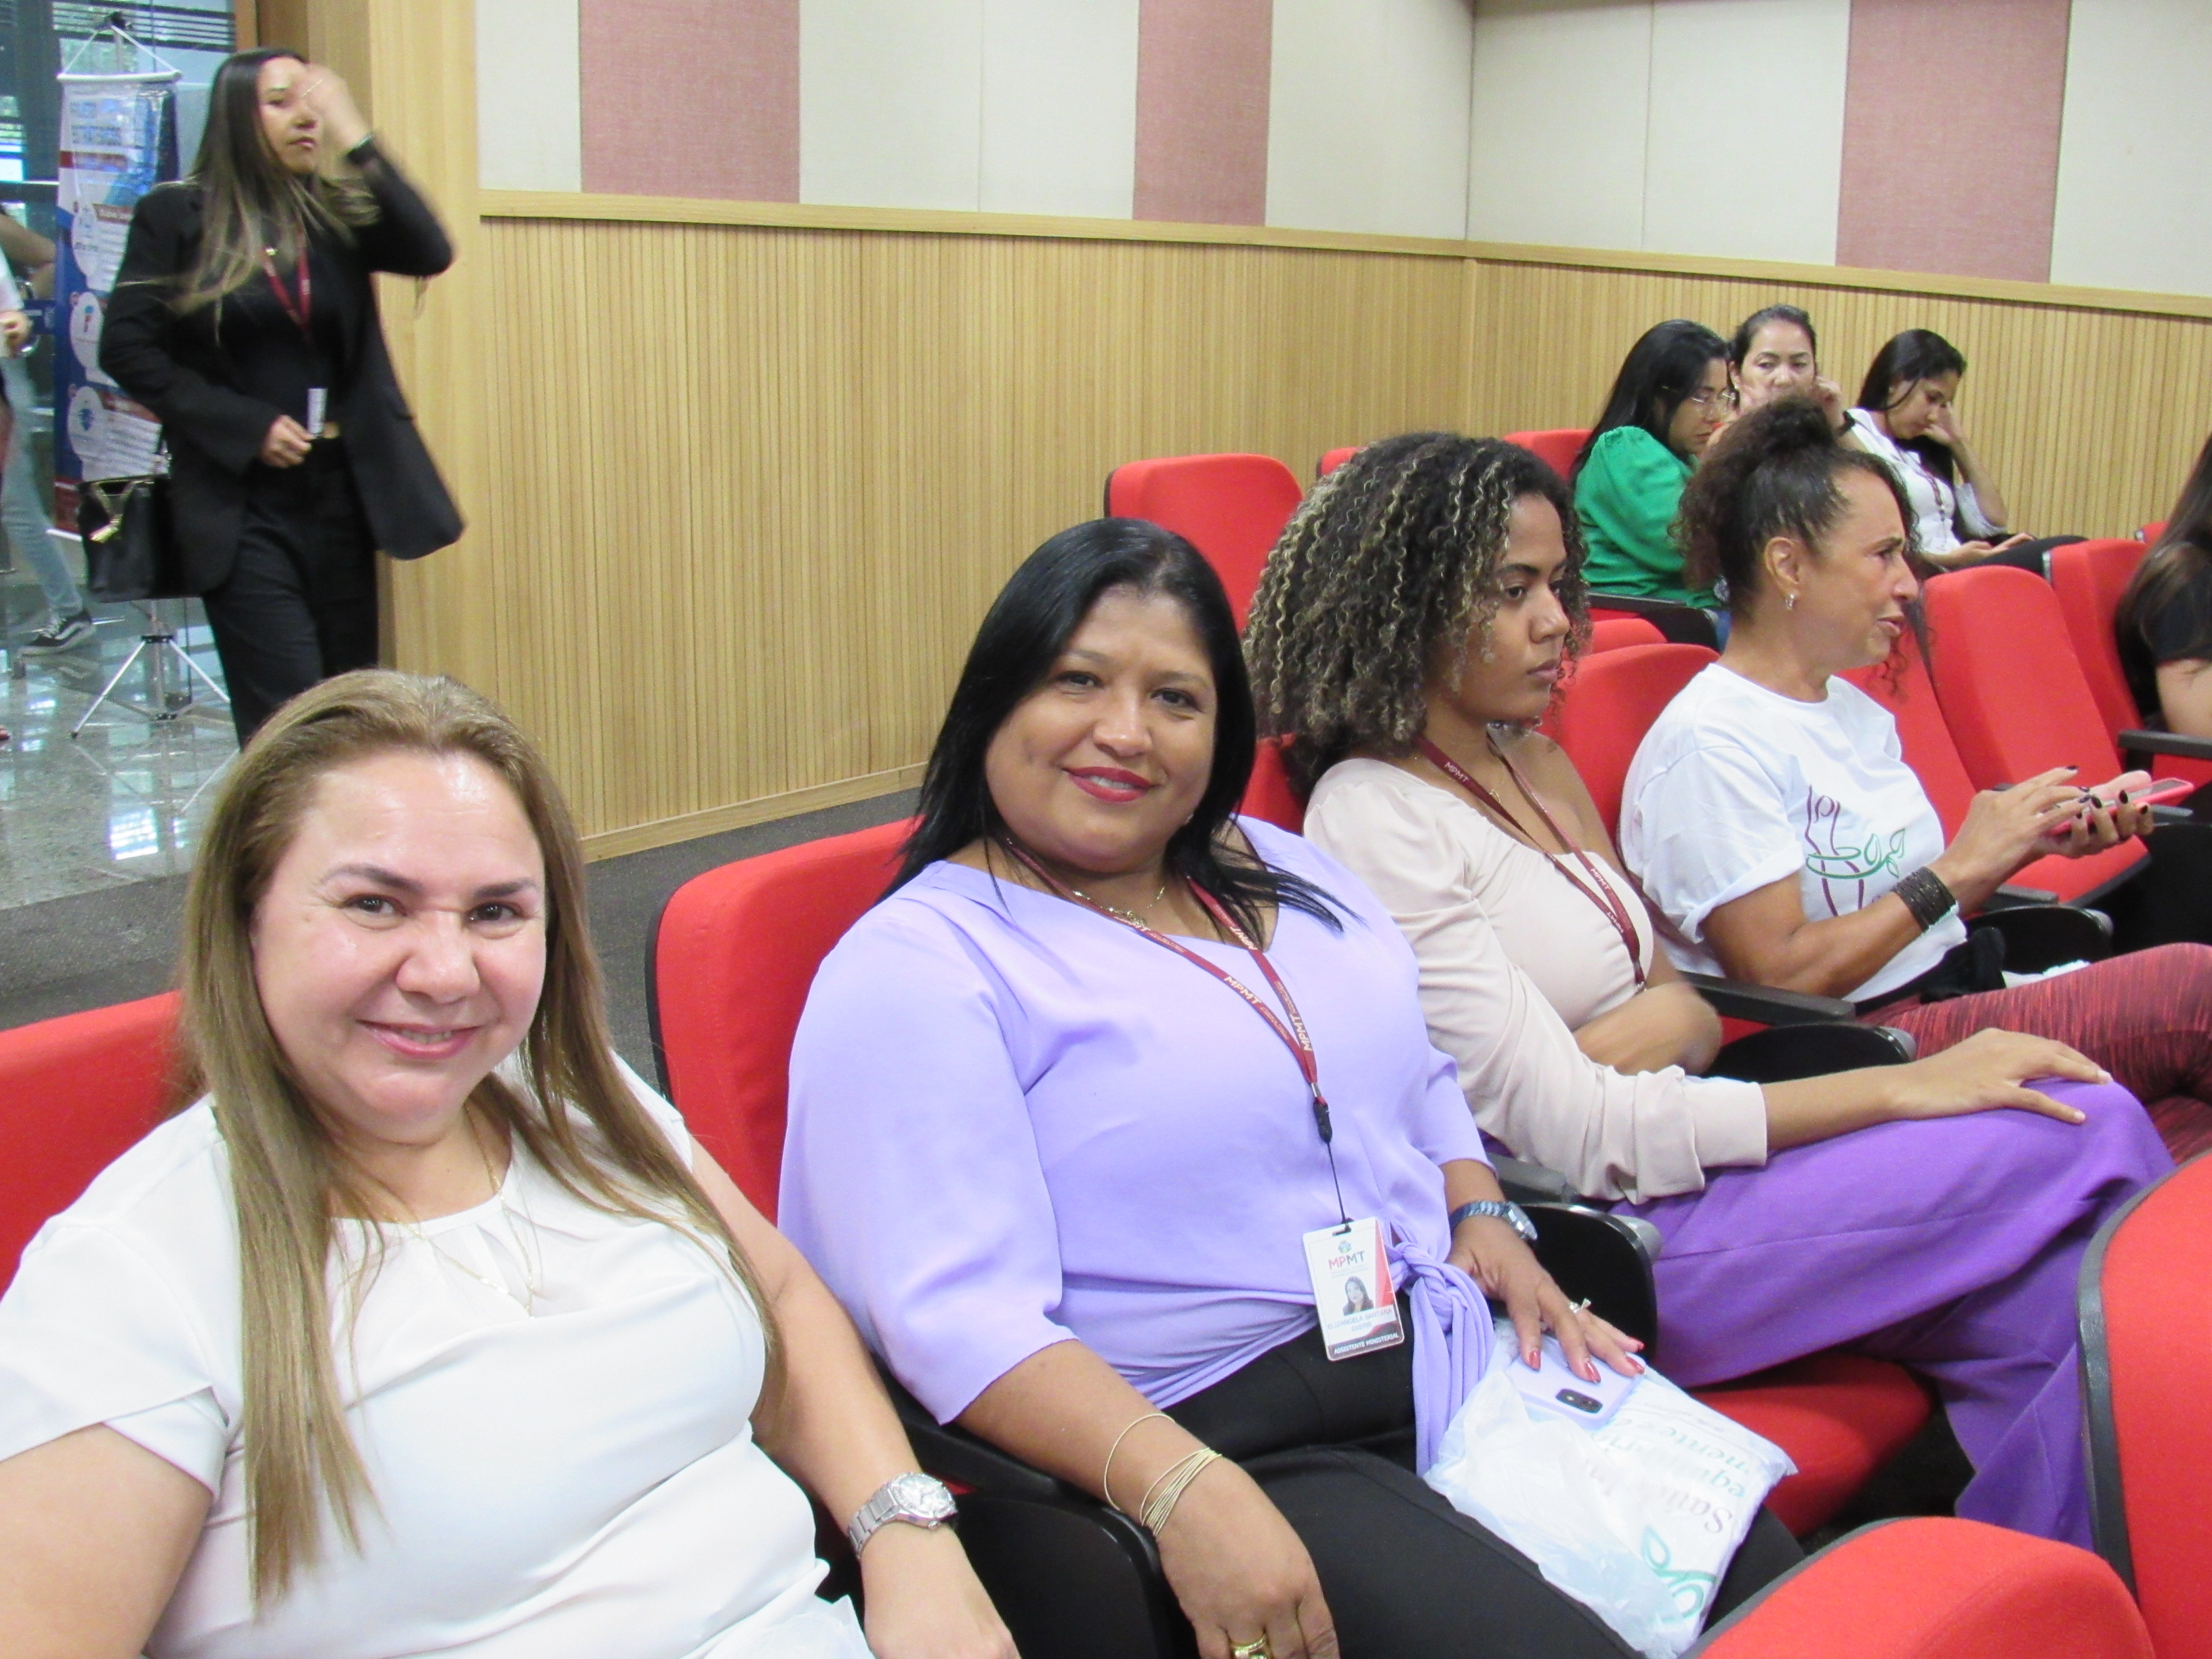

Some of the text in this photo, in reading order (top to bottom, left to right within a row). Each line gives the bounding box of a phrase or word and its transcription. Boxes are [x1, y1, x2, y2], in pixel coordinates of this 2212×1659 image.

[1444, 762, 1469, 782] MPMT
[1591, 868, 1611, 890] MPMT
[1230, 926, 1258, 950] MPMT
[1224, 976, 1263, 1004] MPMT
[1290, 1013, 1313, 1051] MPMT
[1328, 1250, 1365, 1270] MPMT
[1334, 1332, 1398, 1355] ASSISTENTE MINISTERIAL
